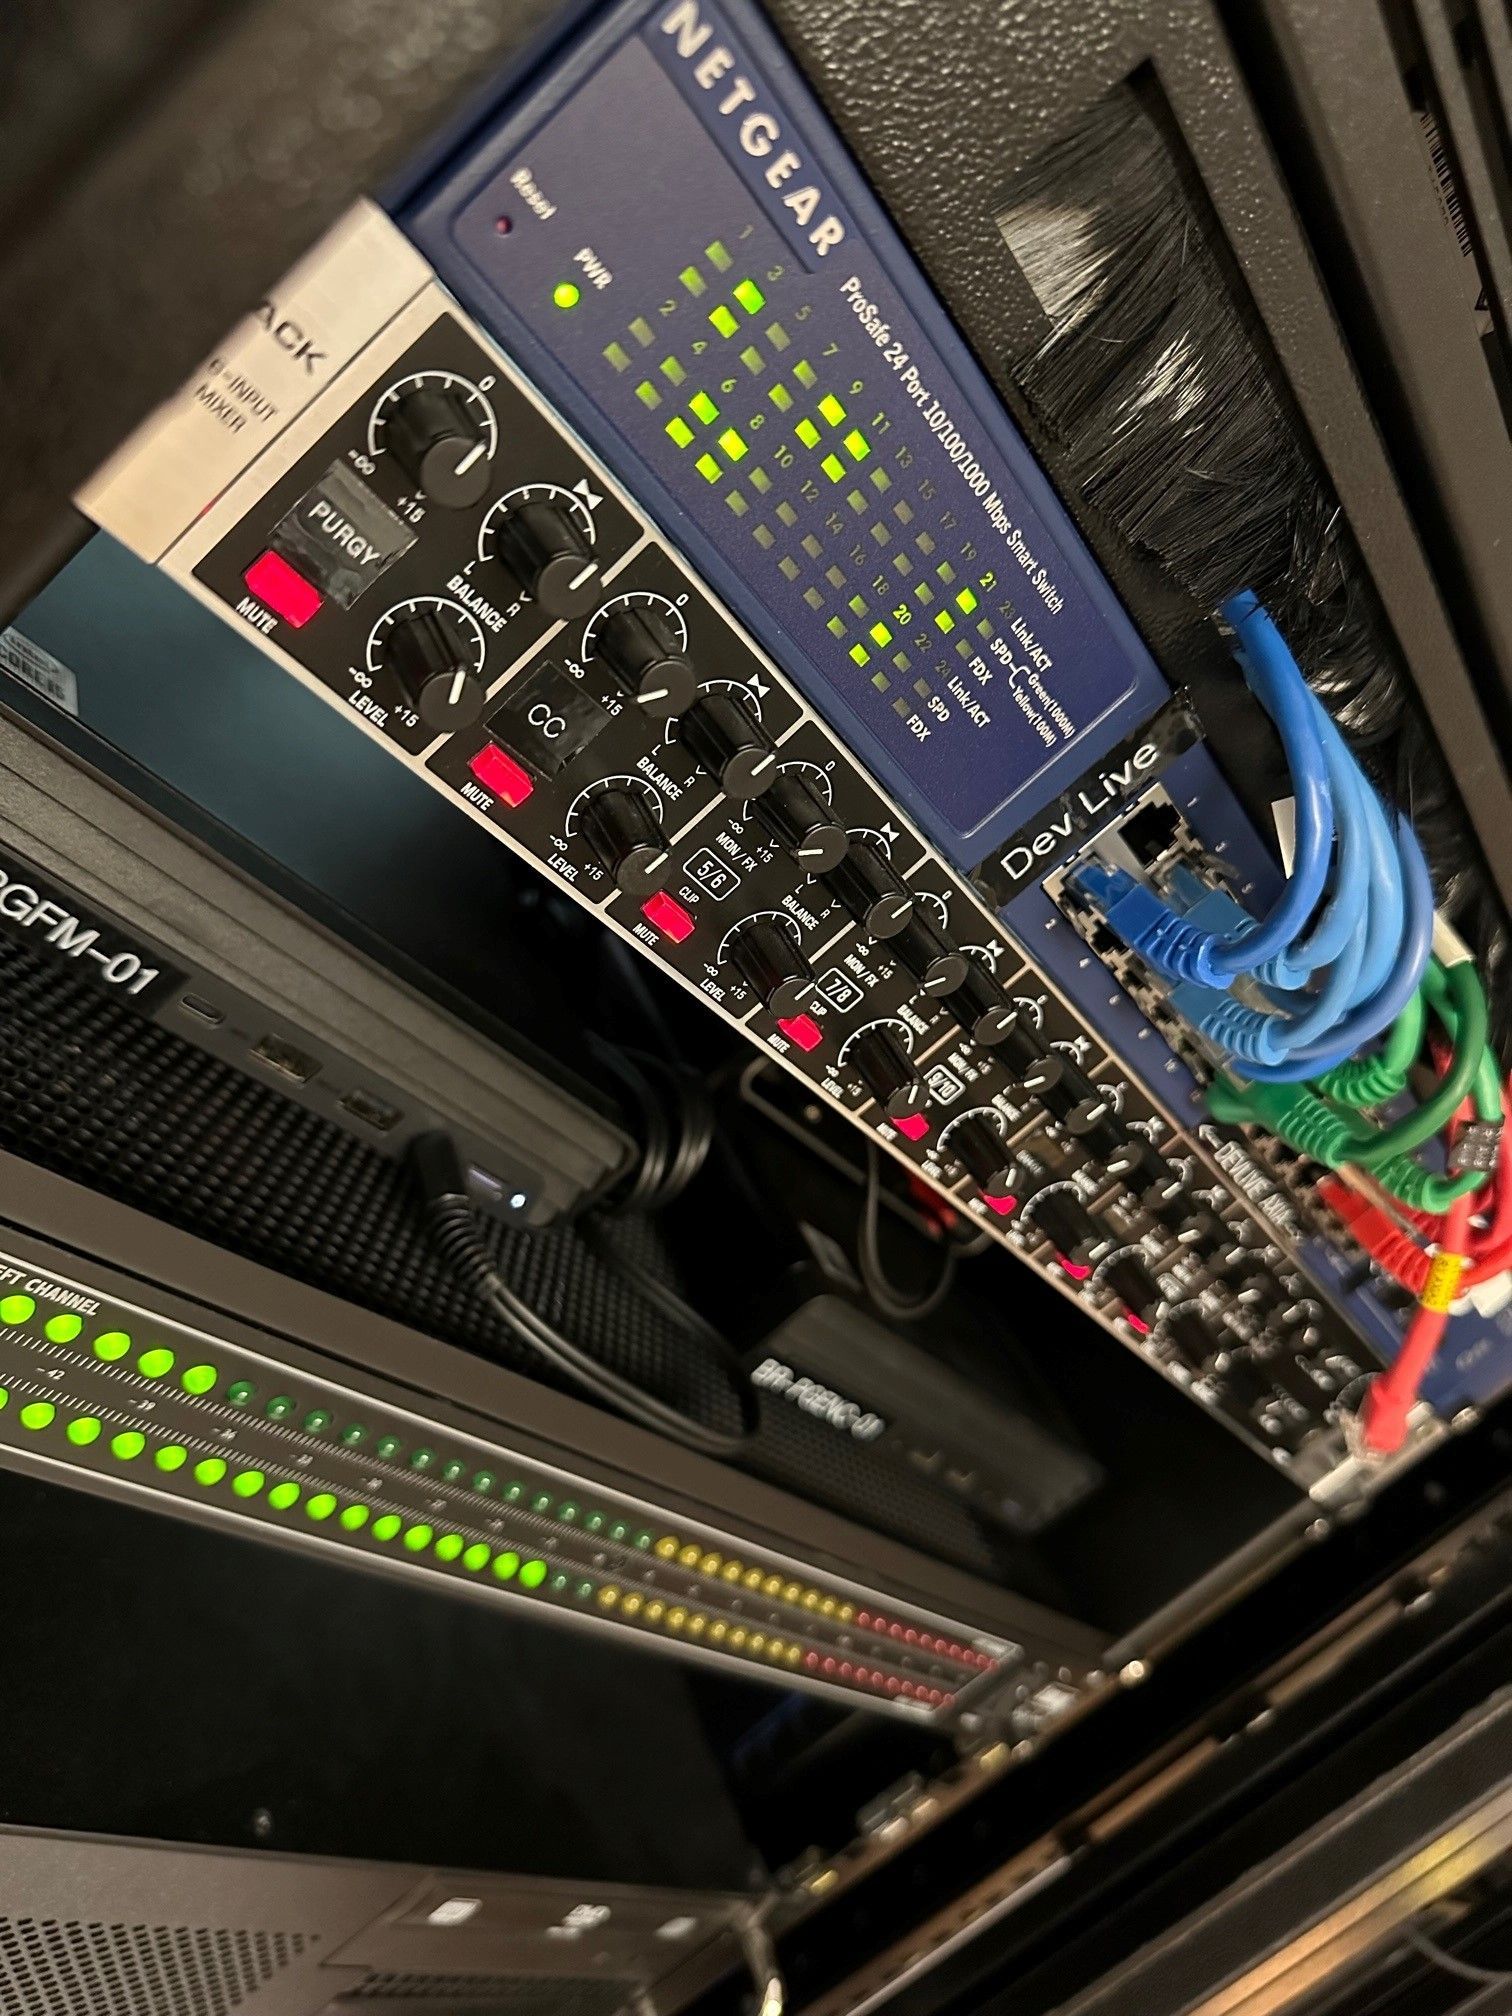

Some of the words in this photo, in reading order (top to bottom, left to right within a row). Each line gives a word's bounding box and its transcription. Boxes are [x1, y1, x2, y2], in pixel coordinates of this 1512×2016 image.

[661, 0, 845, 256] NETGEAR
[573, 247, 613, 290] PWR
[767, 265, 784, 281] 3
[691, 340, 708, 355] 4
[822, 342, 840, 356] 7
[479, 375, 496, 391] 0
[720, 378, 738, 393] 6
[849, 380, 863, 394] 9
[750, 414, 765, 430] 8
[871, 411, 892, 435] 11
[774, 445, 794, 468] 10
[839, 276, 891, 347] ProSafe
[883, 343, 910, 370] 24
[899, 366, 931, 408] Port
[922, 400, 990, 497] 10/100/1000
[982, 491, 1012, 534] Mbps
[1006, 529, 1039, 575] Smart
[1031, 569, 1064, 615] Switch
[895, 446, 914, 469] 13
[801, 479, 820, 503] 12
[918, 479, 936, 501] 15
[825, 512, 845, 535] 14
[939, 511, 957, 530] 17
[308, 500, 381, 565] PURGY
[850, 544, 867, 566] 16
[960, 541, 977, 562] 19
[872, 574, 890, 596] 18
[979, 572, 998, 593] 21
[446, 575, 507, 634] BALANCE
[506, 601, 521, 617] R
[675, 593, 690, 607] 0
[998, 600, 1016, 619] 23
[235, 596, 279, 635] MUTE
[892, 603, 913, 625] 20
[914, 632, 933, 653] 22
[990, 637, 1013, 665] SPD
[1010, 616, 1053, 673] Link/ACT
[968, 656, 994, 686] FDX
[348, 690, 389, 729] LEVEL
[601, 694, 623, 716] +15
[927, 696, 950, 723] SPD
[947, 675, 991, 728] Link/ACT
[1027, 673, 1077, 740] Green(1000M)
[394, 704, 419, 728] +15
[527, 703, 566, 738] CC
[1012, 686, 1057, 748] Yellow(100M)
[906, 714, 932, 742] FDX
[651, 744, 661, 756] L
[825, 761, 836, 772] 0
[636, 756, 683, 801] BALANCE
[684, 776, 695, 788] R
[460, 782, 495, 812] MUTE
[1000, 812, 1073, 880] Dev
[1078, 744, 1159, 815] Live
[756, 846, 774, 863] +15
[547, 853, 580, 882] LEVEL
[583, 863, 604, 881] +15
[697, 860, 726, 889] 5/6
[678, 885, 700, 904] CLIP
[781, 895, 820, 931] BALANCE
[820, 908, 830, 919] R
[632, 922, 659, 946] MUTE
[700, 978, 726, 1003] LEVEL
[730, 984, 748, 1000] +15
[824, 978, 853, 1003] 7/8
[809, 1000, 828, 1017] CLIP
[896, 1004, 930, 1035] BALANCE
[766, 1033, 791, 1054] MUTE
[928, 1071, 957, 1099] 9/10
[24, 1278, 101, 1316] CHANNEL
